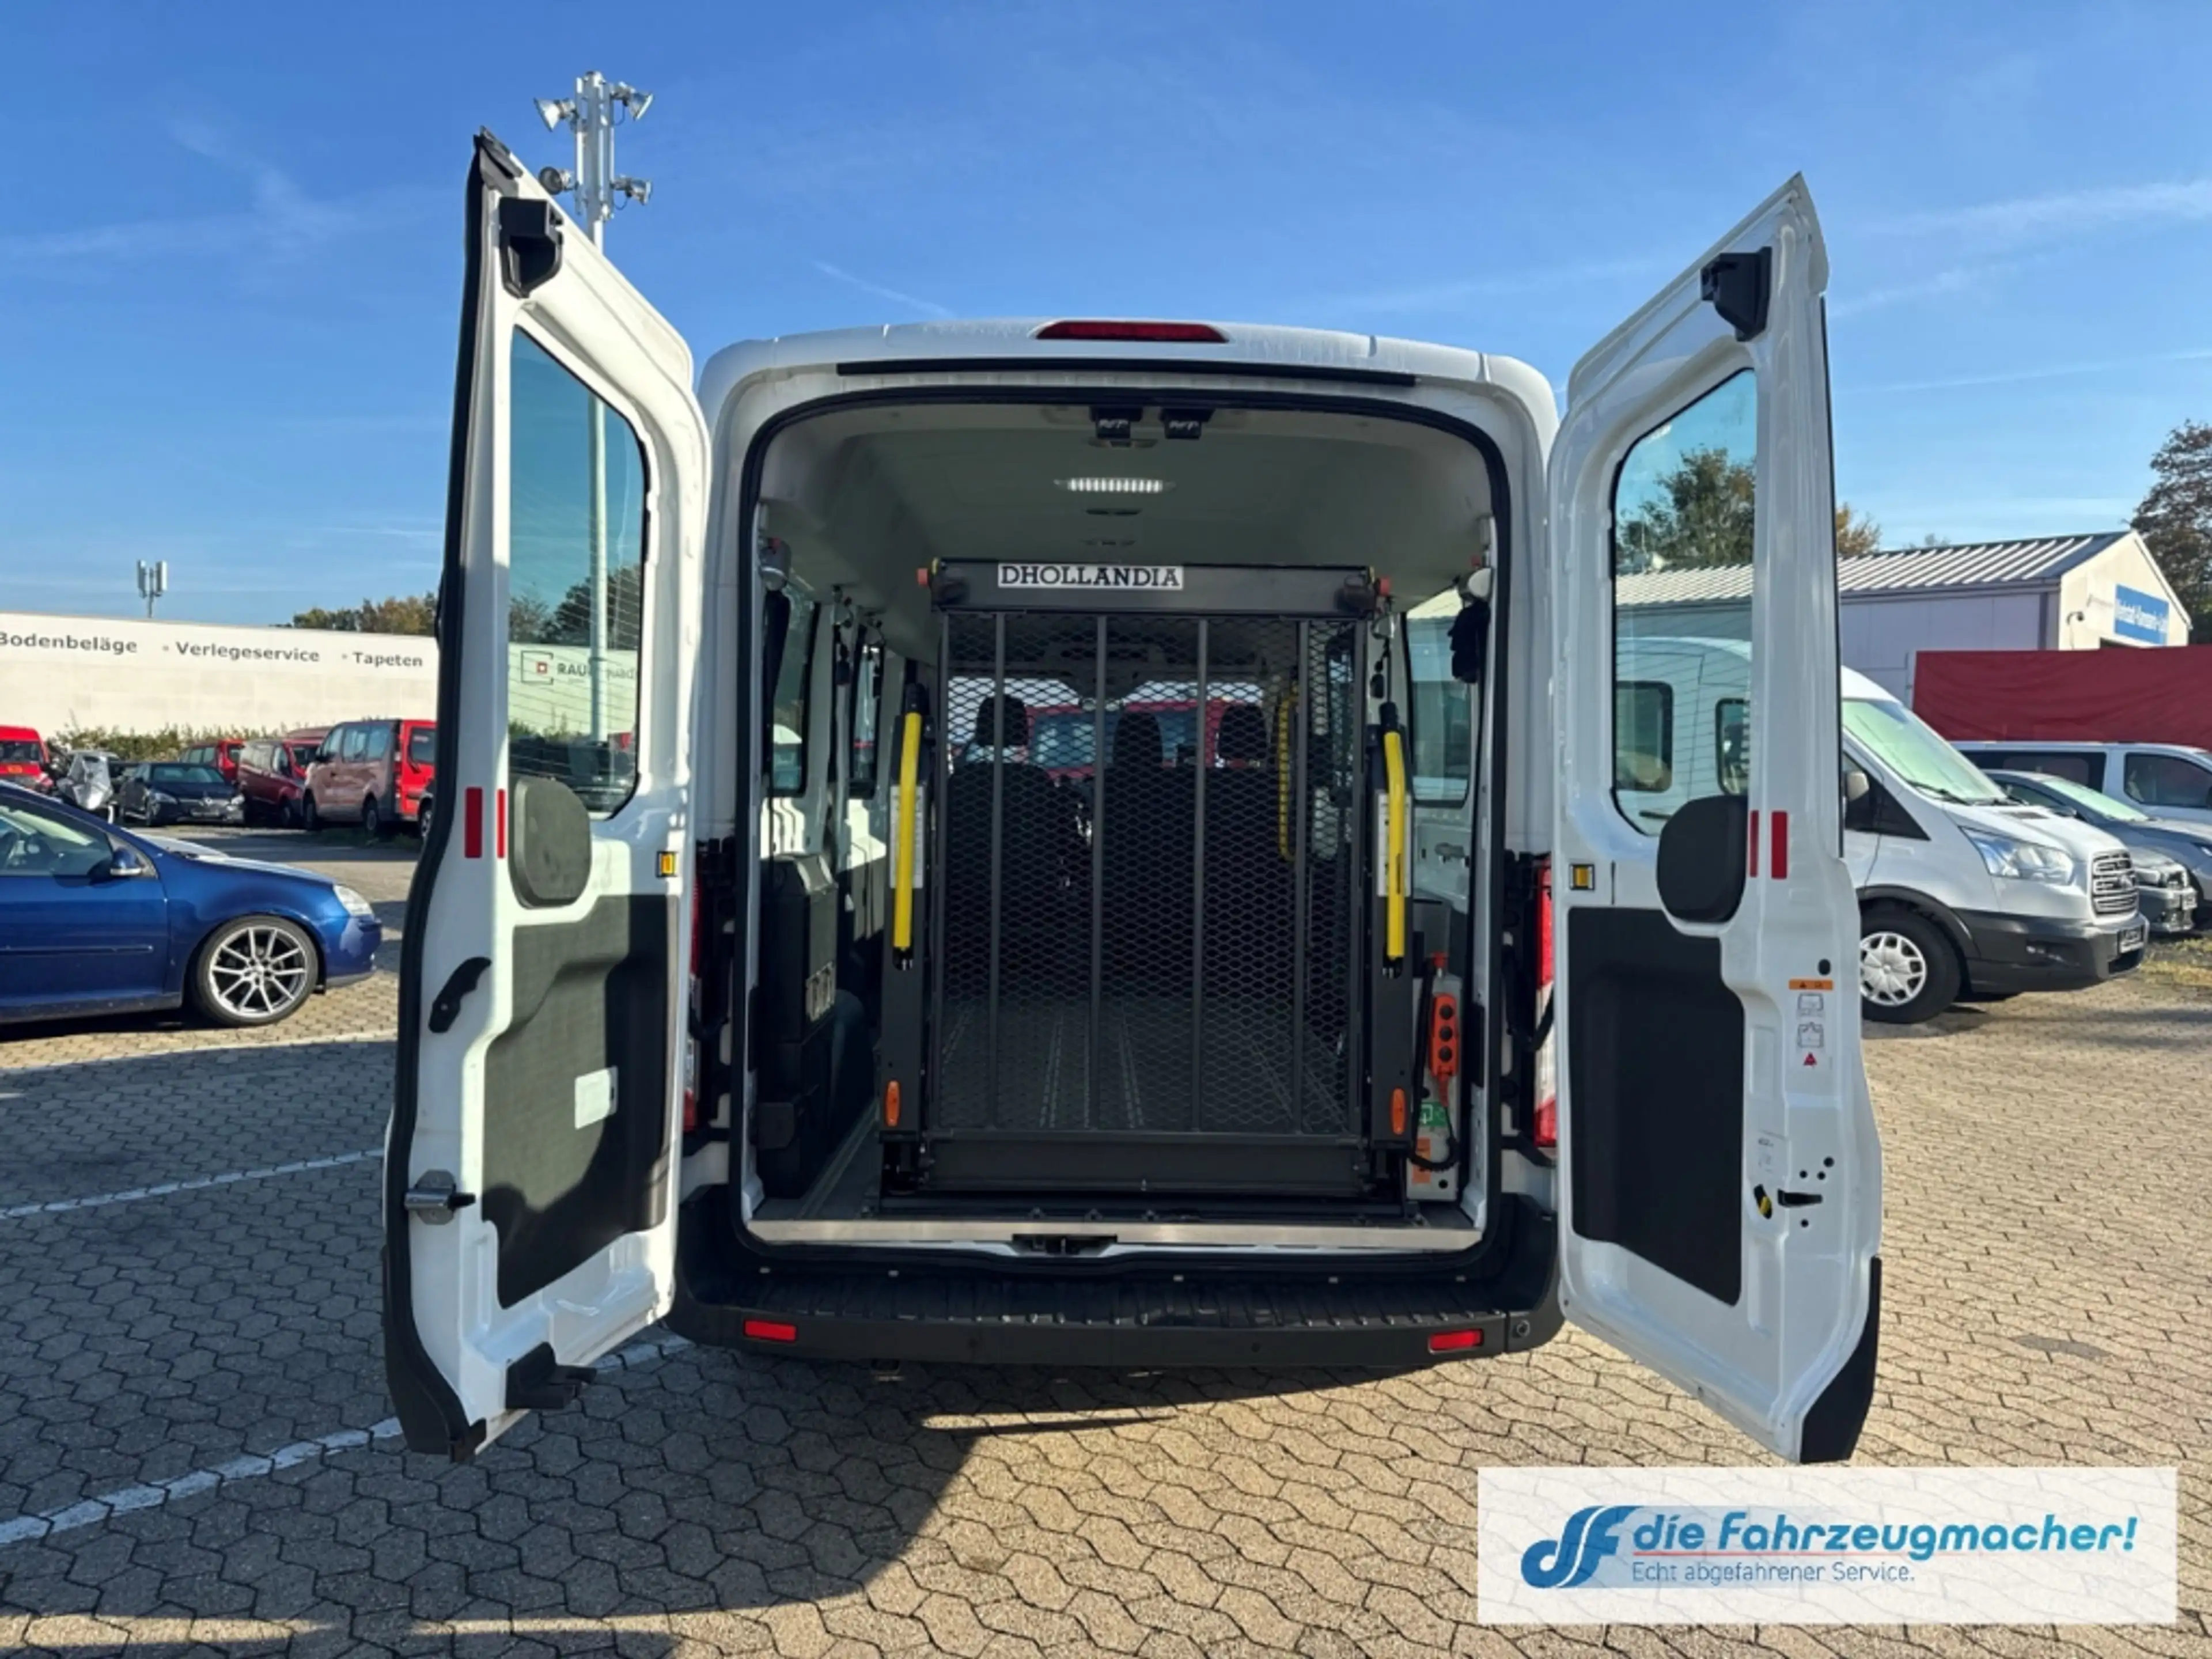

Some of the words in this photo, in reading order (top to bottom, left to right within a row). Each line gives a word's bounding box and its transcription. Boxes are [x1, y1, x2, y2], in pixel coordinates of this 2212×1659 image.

[1001, 566, 1180, 586] DHOLLANDIA
[176, 641, 320, 662] Verlegeservice
[352, 652, 423, 668] Tapeten
